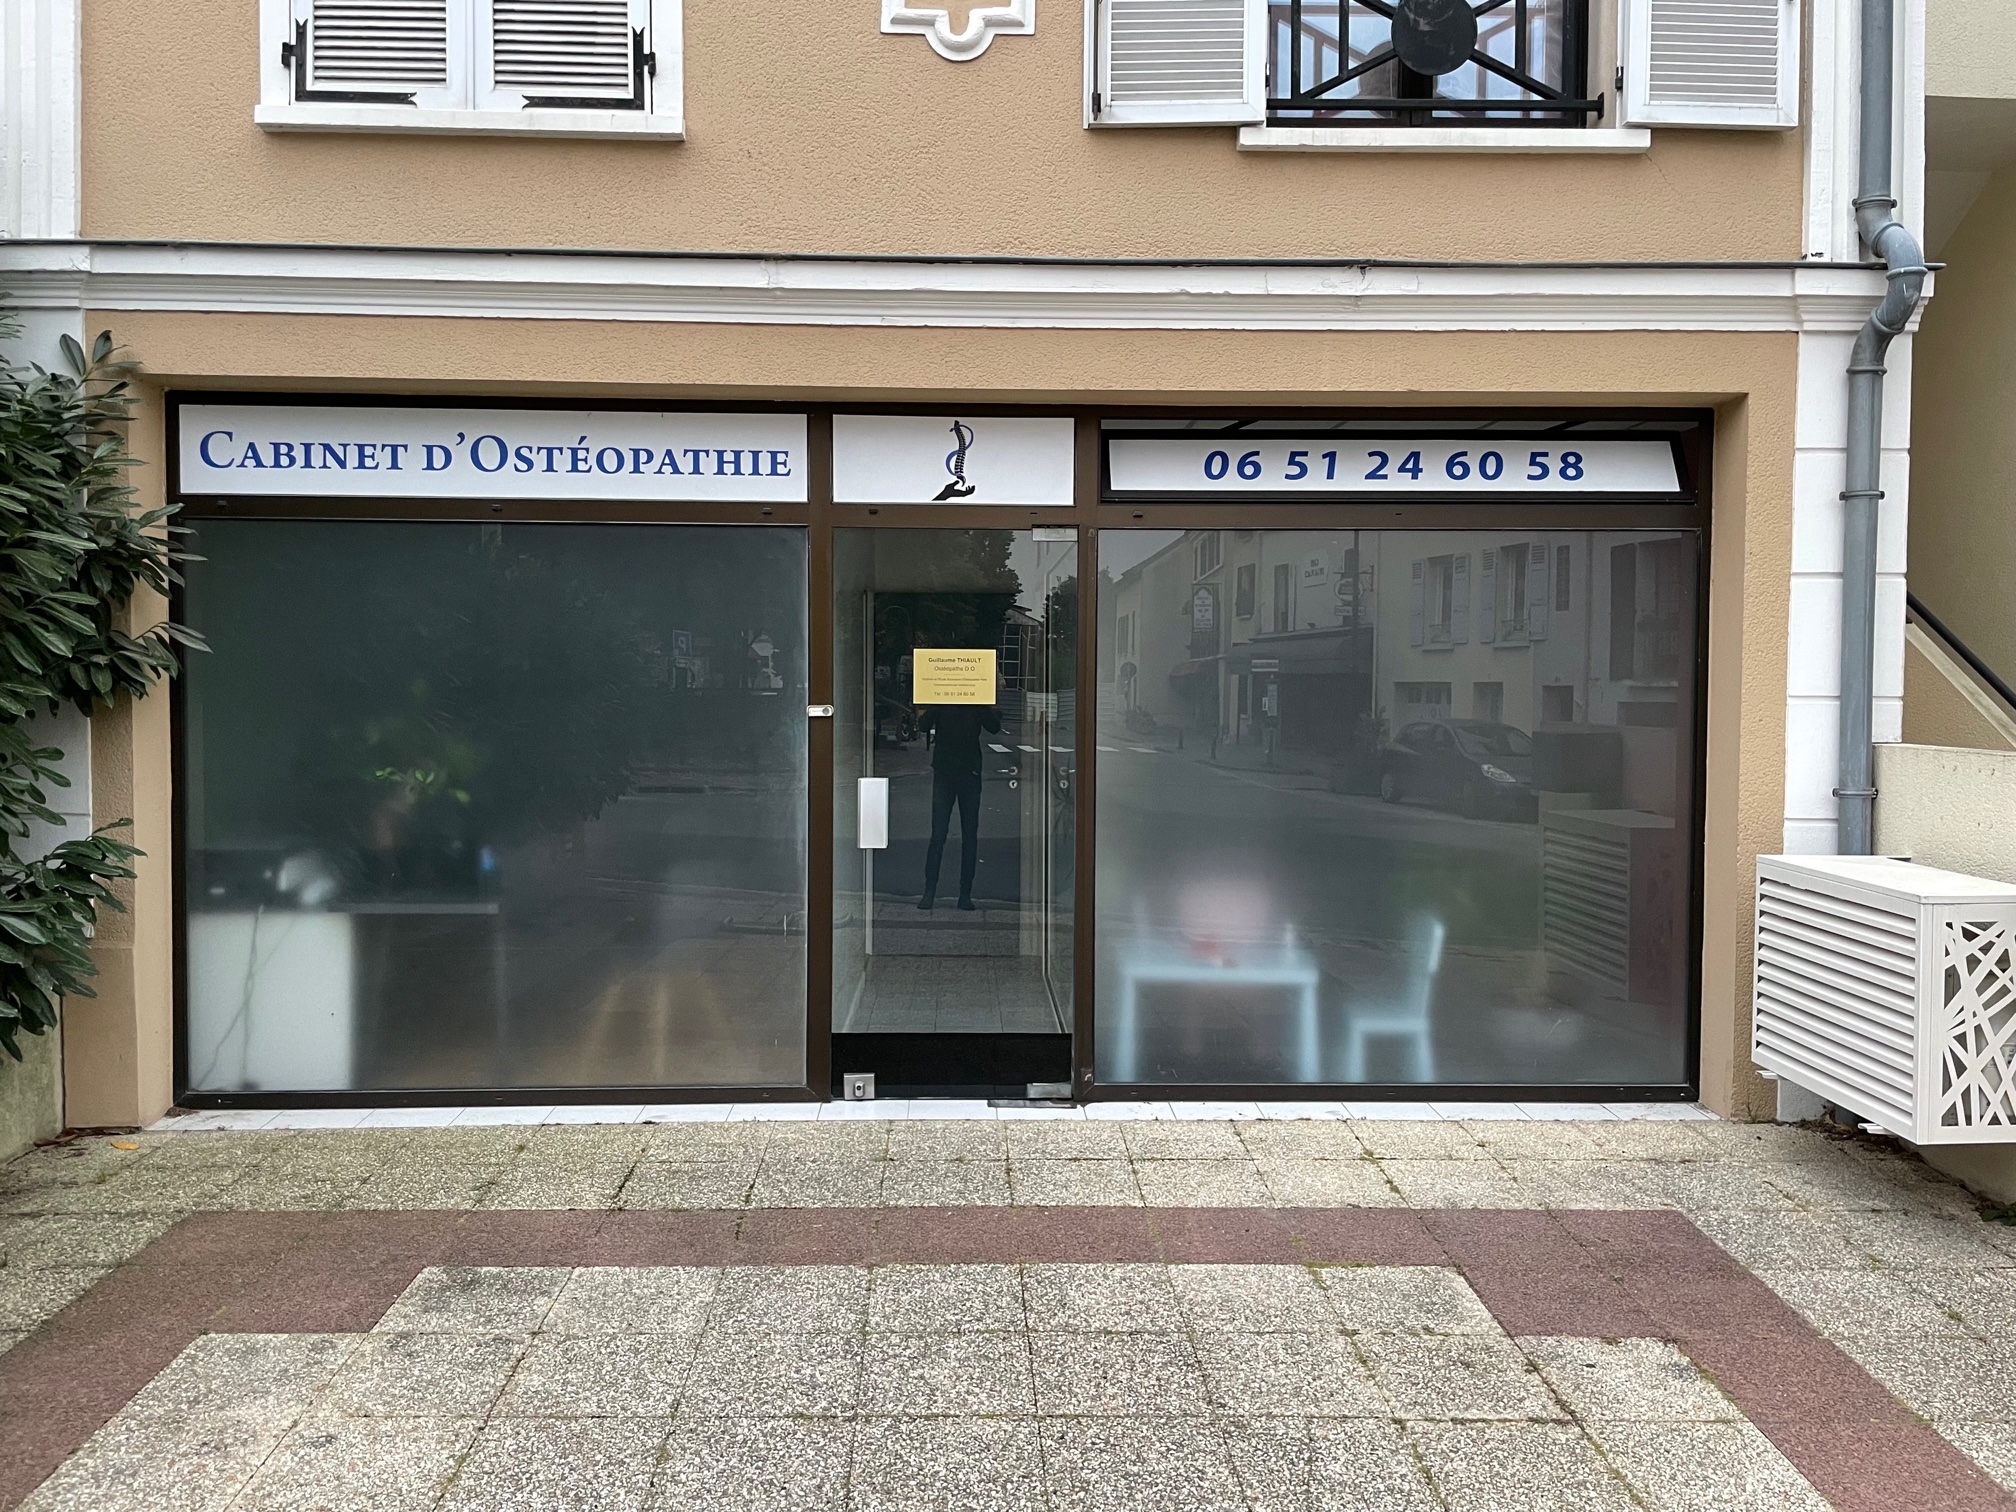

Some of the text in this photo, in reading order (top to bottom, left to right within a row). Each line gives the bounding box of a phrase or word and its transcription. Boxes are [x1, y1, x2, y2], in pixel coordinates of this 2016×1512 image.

[1204, 451, 1584, 481] 06 51 24 60 58
